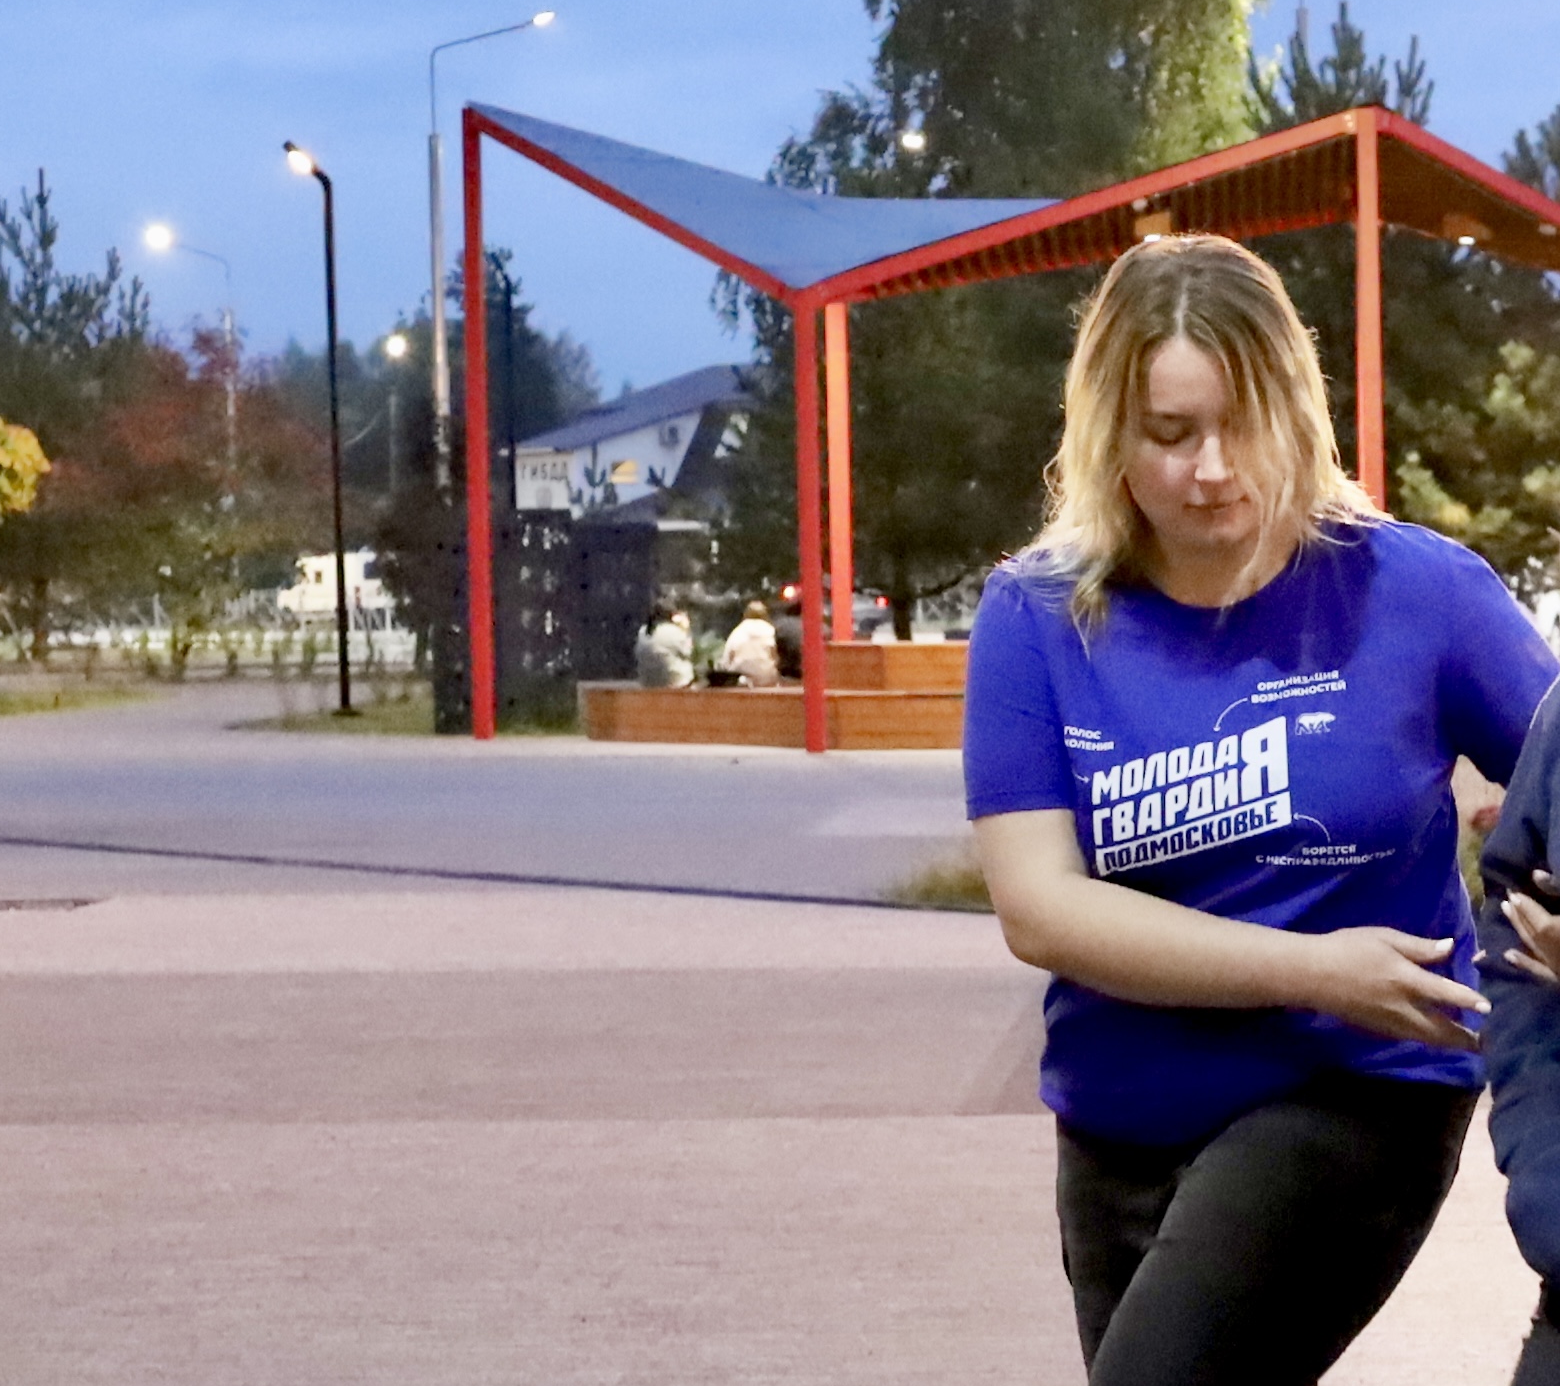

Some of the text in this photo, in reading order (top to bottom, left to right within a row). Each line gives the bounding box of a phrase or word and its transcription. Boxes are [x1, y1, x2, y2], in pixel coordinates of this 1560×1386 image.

[1251, 679, 1347, 704] ВОЗМОЖНОСТЕЙ
[1257, 670, 1339, 691] ОРГАНИЗАЦИЯ
[1064, 725, 1102, 740] ГОЛОС
[1092, 716, 1289, 805] МОЛОДАЯ
[1103, 800, 1278, 871] ПОДМОСКОВЬЕ
[1302, 844, 1357, 855] БОРЕТСЯ
